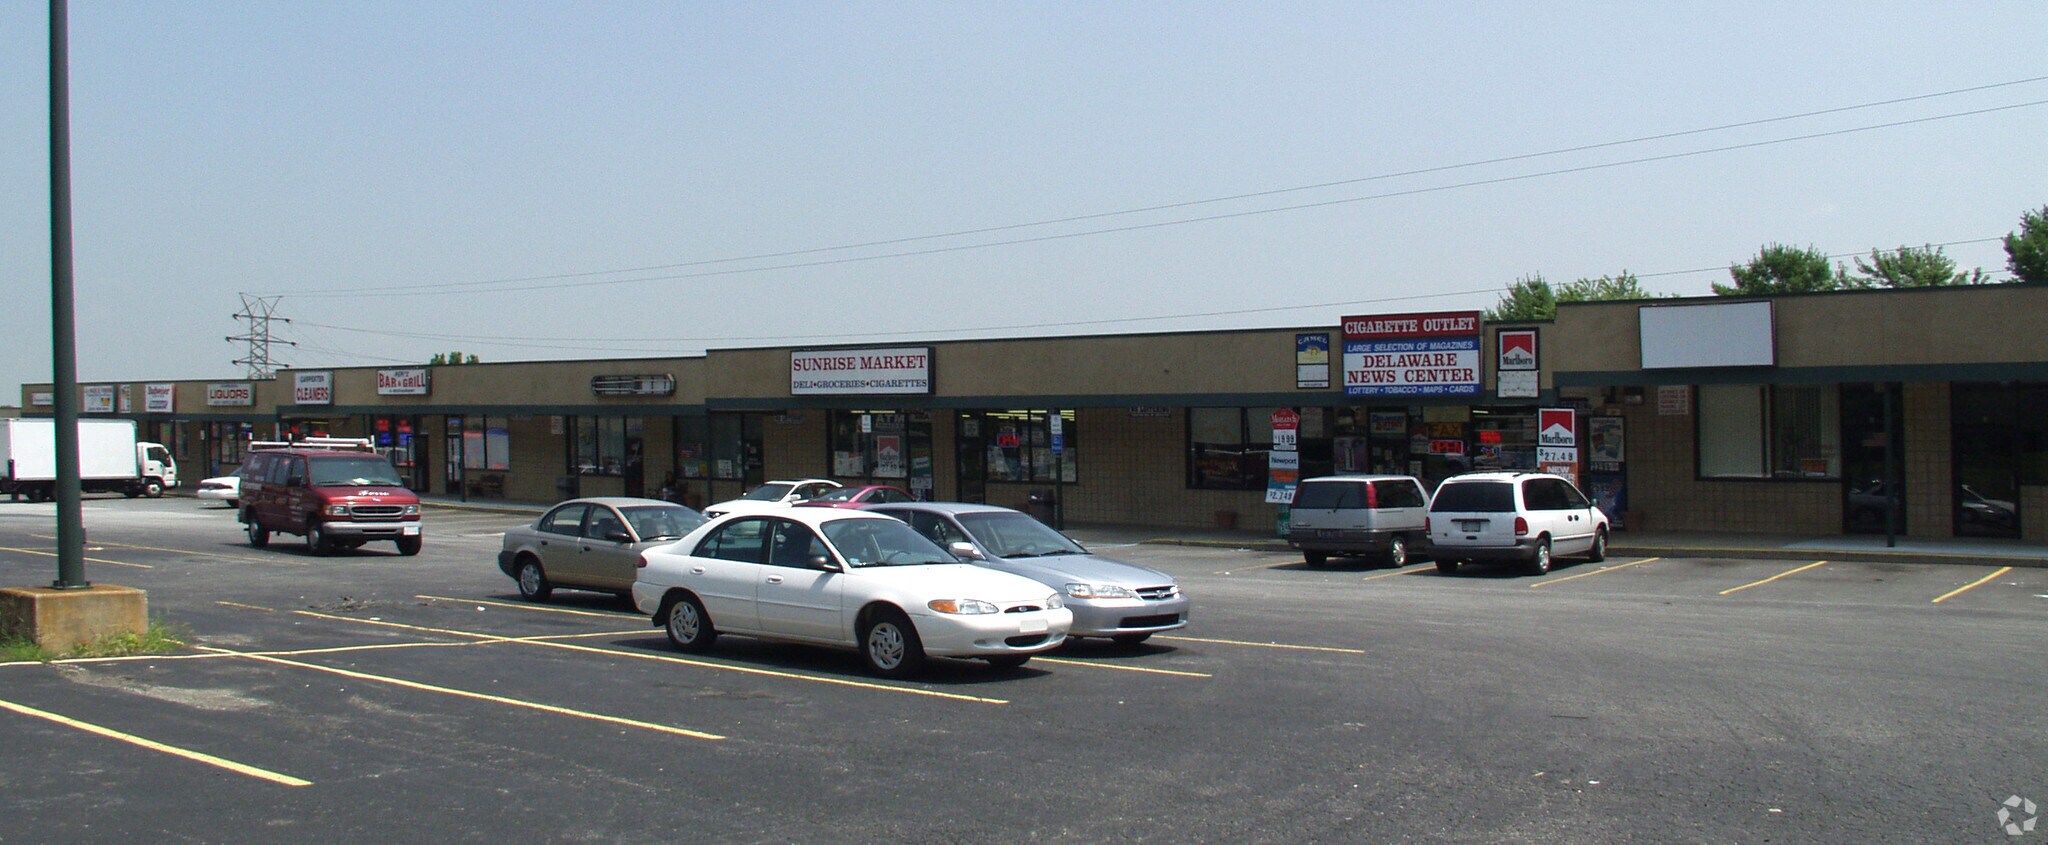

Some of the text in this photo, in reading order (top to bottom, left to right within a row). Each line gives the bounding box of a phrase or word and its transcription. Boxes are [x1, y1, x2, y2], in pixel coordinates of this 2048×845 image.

[1345, 317, 1475, 334] CIGARETTE OUTLET
[1298, 335, 1328, 345] CAMEL
[1347, 341, 1474, 352] LARGE SELECTION OF MAGAZINES
[793, 355, 926, 371] SUNRISE MARKET
[1363, 353, 1457, 368] DELAWARE
[1502, 353, 1533, 365] Marlboro
[379, 373, 397, 387] BAR
[402, 373, 426, 387] GRILL
[1347, 368, 1474, 383] NEWS CENTER
[793, 379, 927, 389] DELI GROCERIES CIGARETTES
[1384, 386, 1418, 394] TOBACCO
[1449, 385, 1475, 393] CARDS
[210, 389, 249, 399] LIQUORS
[297, 387, 329, 401] CLEANERS
[1541, 432, 1573, 444] Marlboro
[1429, 441, 1462, 453] OPEN
[1271, 457, 1297, 465] Newport
[1546, 465, 1570, 473] NEW
